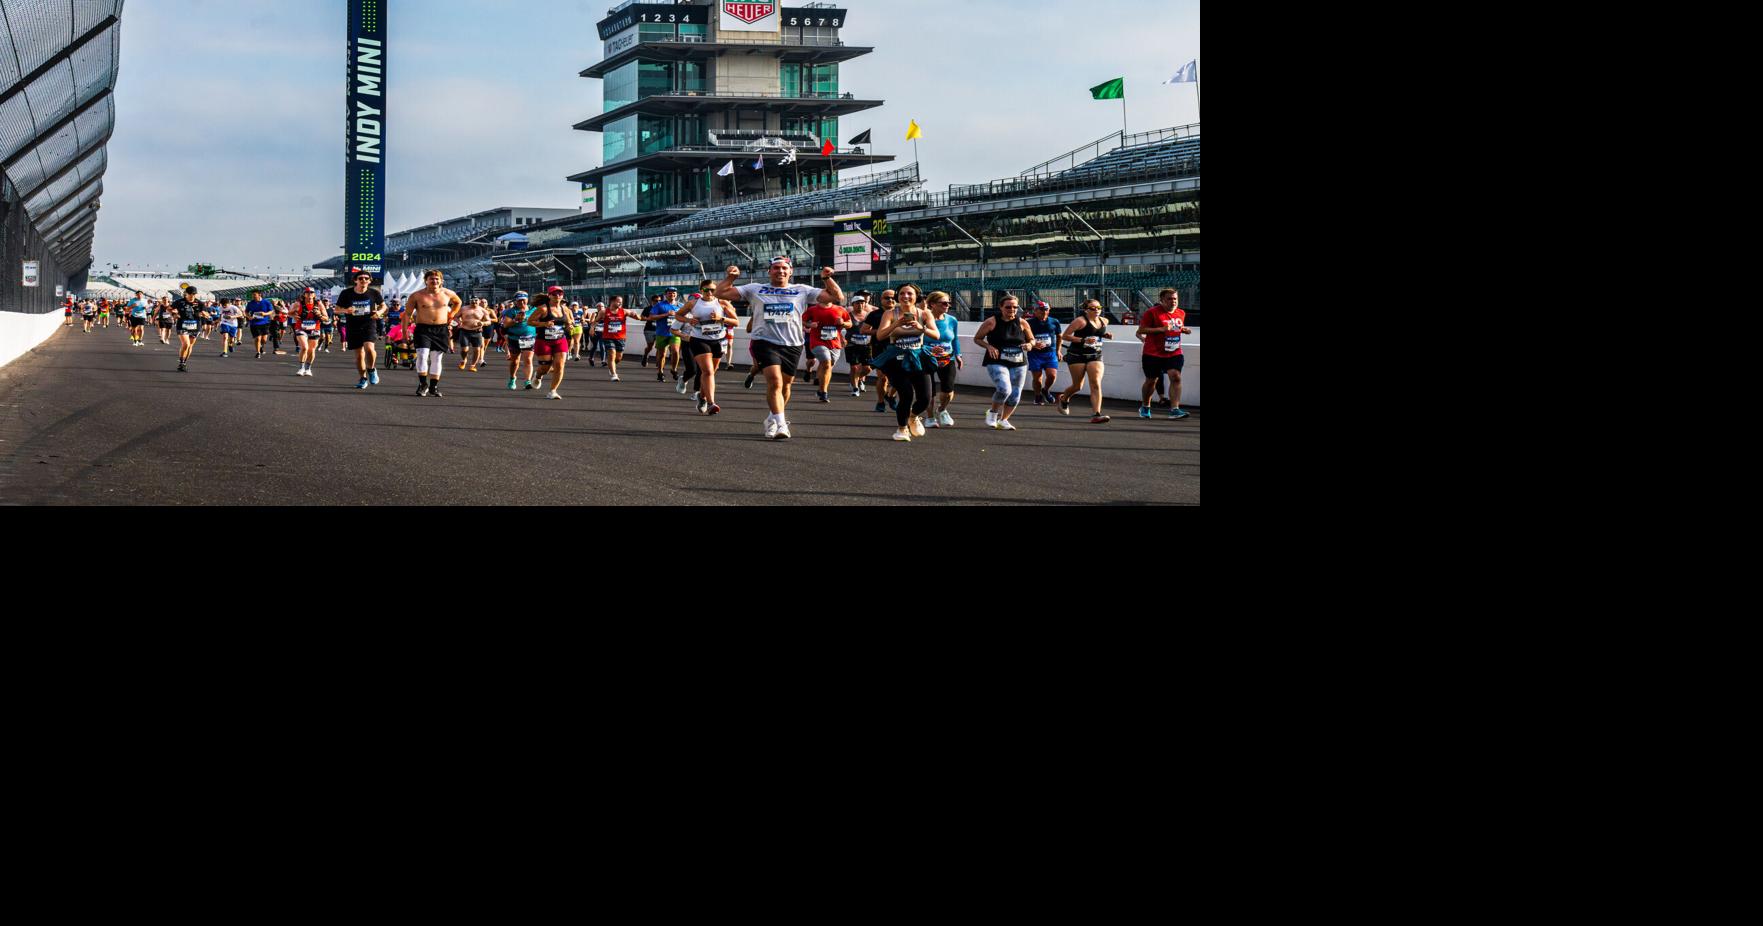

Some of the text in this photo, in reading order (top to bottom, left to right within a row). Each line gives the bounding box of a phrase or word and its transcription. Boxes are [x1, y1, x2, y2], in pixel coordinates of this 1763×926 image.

[727, 4, 772, 20] HEUER
[640, 13, 690, 22] 1 2 3 4
[790, 17, 839, 26] 5 6 7 8
[356, 37, 382, 163] INDY MINI
[351, 253, 382, 261] 2024
